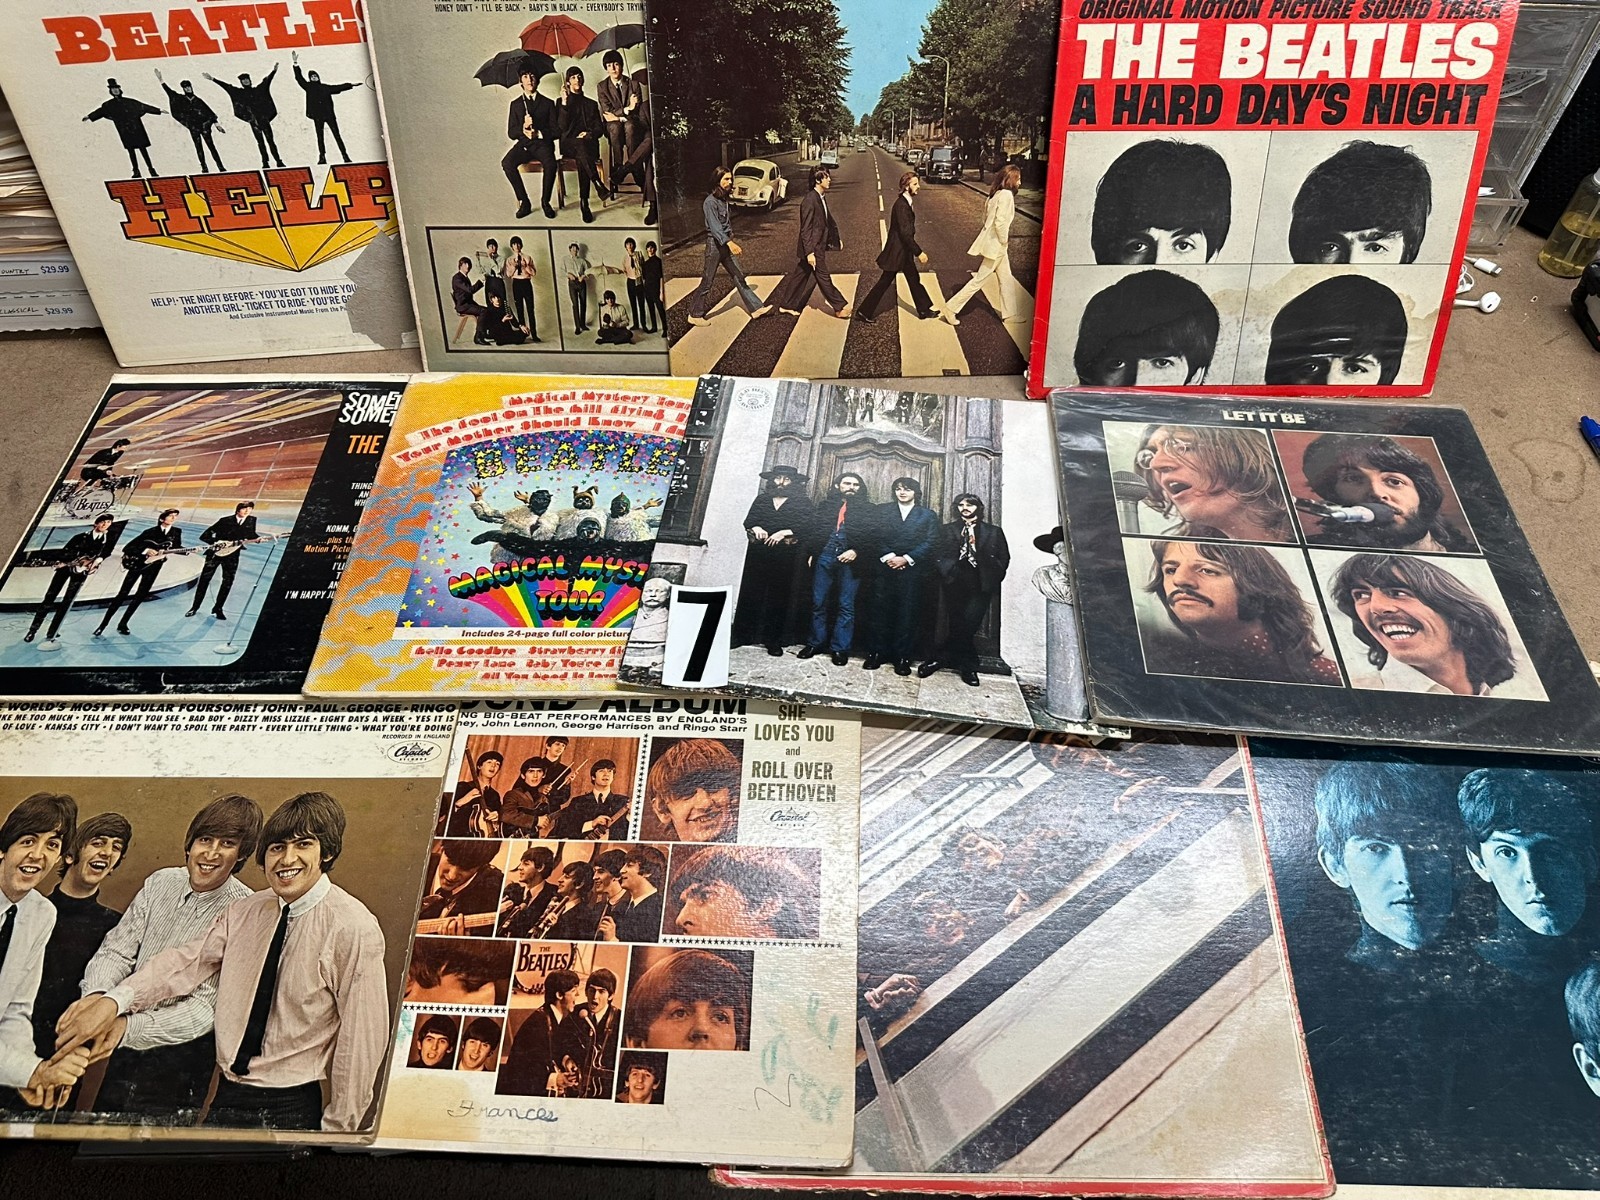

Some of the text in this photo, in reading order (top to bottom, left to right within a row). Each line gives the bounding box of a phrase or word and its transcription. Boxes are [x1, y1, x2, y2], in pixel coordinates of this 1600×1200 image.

[435, 3, 624, 12] HONEY DON'T I'LL BE BACK BABY'S IN BLACK EVERYBODY'S
[1079, 0, 1501, 19] ORIGINAL MOTION PICTURE SOUND TRACK
[1076, 22, 1499, 80] THE BEATLES
[1068, 83, 1488, 126] A HARD DAY'S NIGHT
[104, 161, 394, 240] HELP
[40, 265, 70, 274] $29.99
[151, 285, 340, 307] HELP! THE NIGHT BEFORE YOU'VE GOT TO HIDE
[184, 296, 341, 316] ANOTHER GIRL TICKET TO RIDE YOU'RE
[265, 308, 298, 317] Instrumental
[419, 426, 453, 440] The
[502, 410, 528, 420] On
[1222, 410, 1306, 424] LET IT BE
[347, 435, 384, 454] THE
[396, 416, 636, 462] Your Mother Should Know
[76, 498, 110, 512] BEATLES
[326, 524, 350, 534] KOMM,
[304, 544, 329, 552] Motion
[448, 554, 569, 600] MAGICAL
[284, 590, 326, 599] I'M HAPPY
[535, 589, 607, 621] TOUR
[462, 630, 596, 638] Includes 24-page full color
[676, 590, 728, 682] 7
[8, 702, 456, 713] WORLD'S MOST POPULAR FOURSOME! JOHN PAUL GEORGE RINGO
[778, 704, 806, 722] SHE
[119, 714, 142, 722] WHAT
[146, 714, 162, 722] YOU
[484, 712, 542, 720] BIG-BEAT
[547, 713, 652, 722] PERFORMANCES
[678, 716, 748, 724] ENGLAND'S
[514, 720, 558, 728] Lennon,
[562, 721, 602, 730] George
[606, 722, 654, 730] Harrison
[682, 724, 716, 732] Ringo
[720, 724, 748, 732] Starr
[184, 724, 208, 732] SPOIL
[212, 724, 227, 732] THE
[229, 724, 257, 732] PARTY
[266, 724, 293, 732] EVERY
[295, 724, 322, 732] LITTLE
[326, 724, 352, 732] THING
[362, 724, 387, 732] WHAT
[390, 724, 421, 732] YOU'RE
[424, 724, 452, 732] DOING
[754, 724, 834, 742] LOVES YOU
[394, 746, 434, 758] Capitol
[785, 746, 800, 756] and
[752, 760, 834, 780] ROLL OVER
[748, 782, 836, 802] BEETHOVEN
[516, 943, 569, 978] BEATLES
